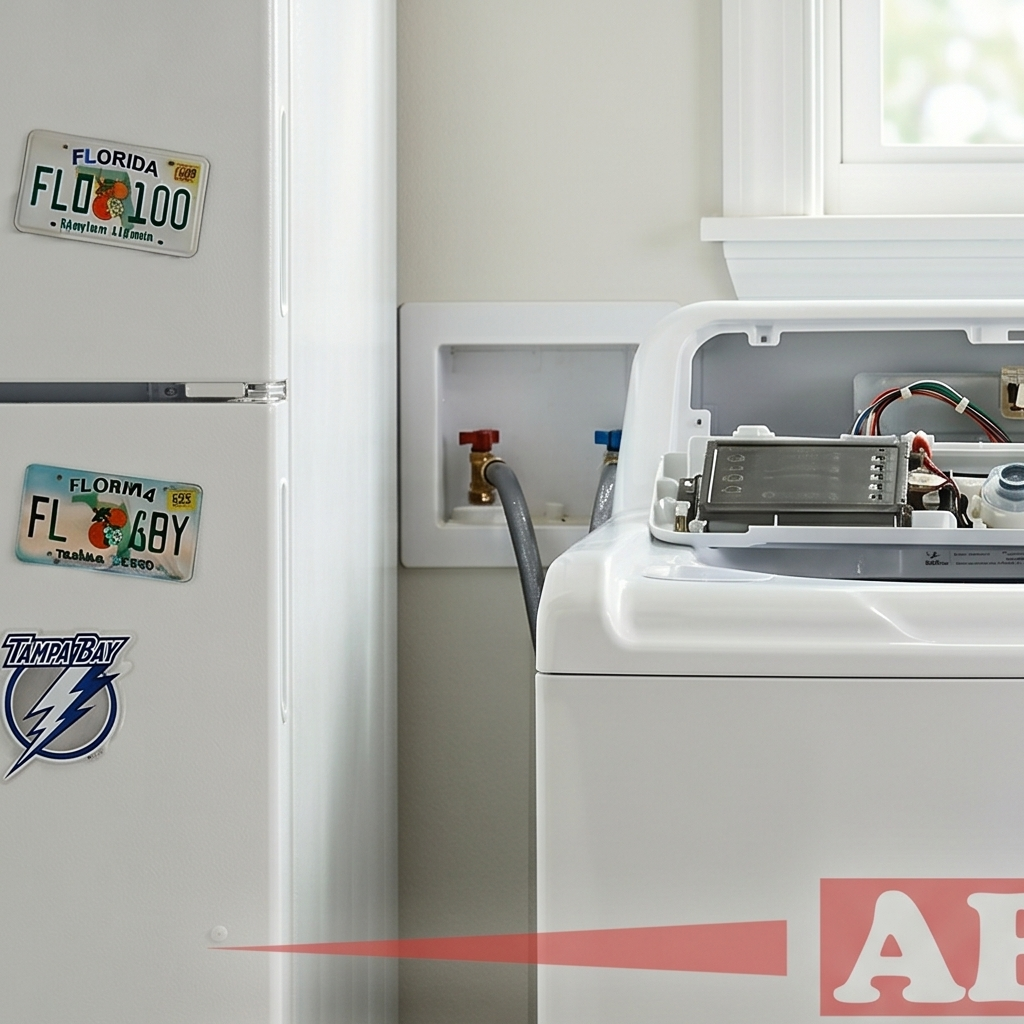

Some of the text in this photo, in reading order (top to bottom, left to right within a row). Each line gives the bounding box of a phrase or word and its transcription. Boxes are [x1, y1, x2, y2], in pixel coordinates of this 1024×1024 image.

[72, 148, 159, 178] FLORIDA
[128, 181, 191, 230] 100
[27, 495, 67, 543] FL
[5, 635, 126, 665] TAMPA BAY
